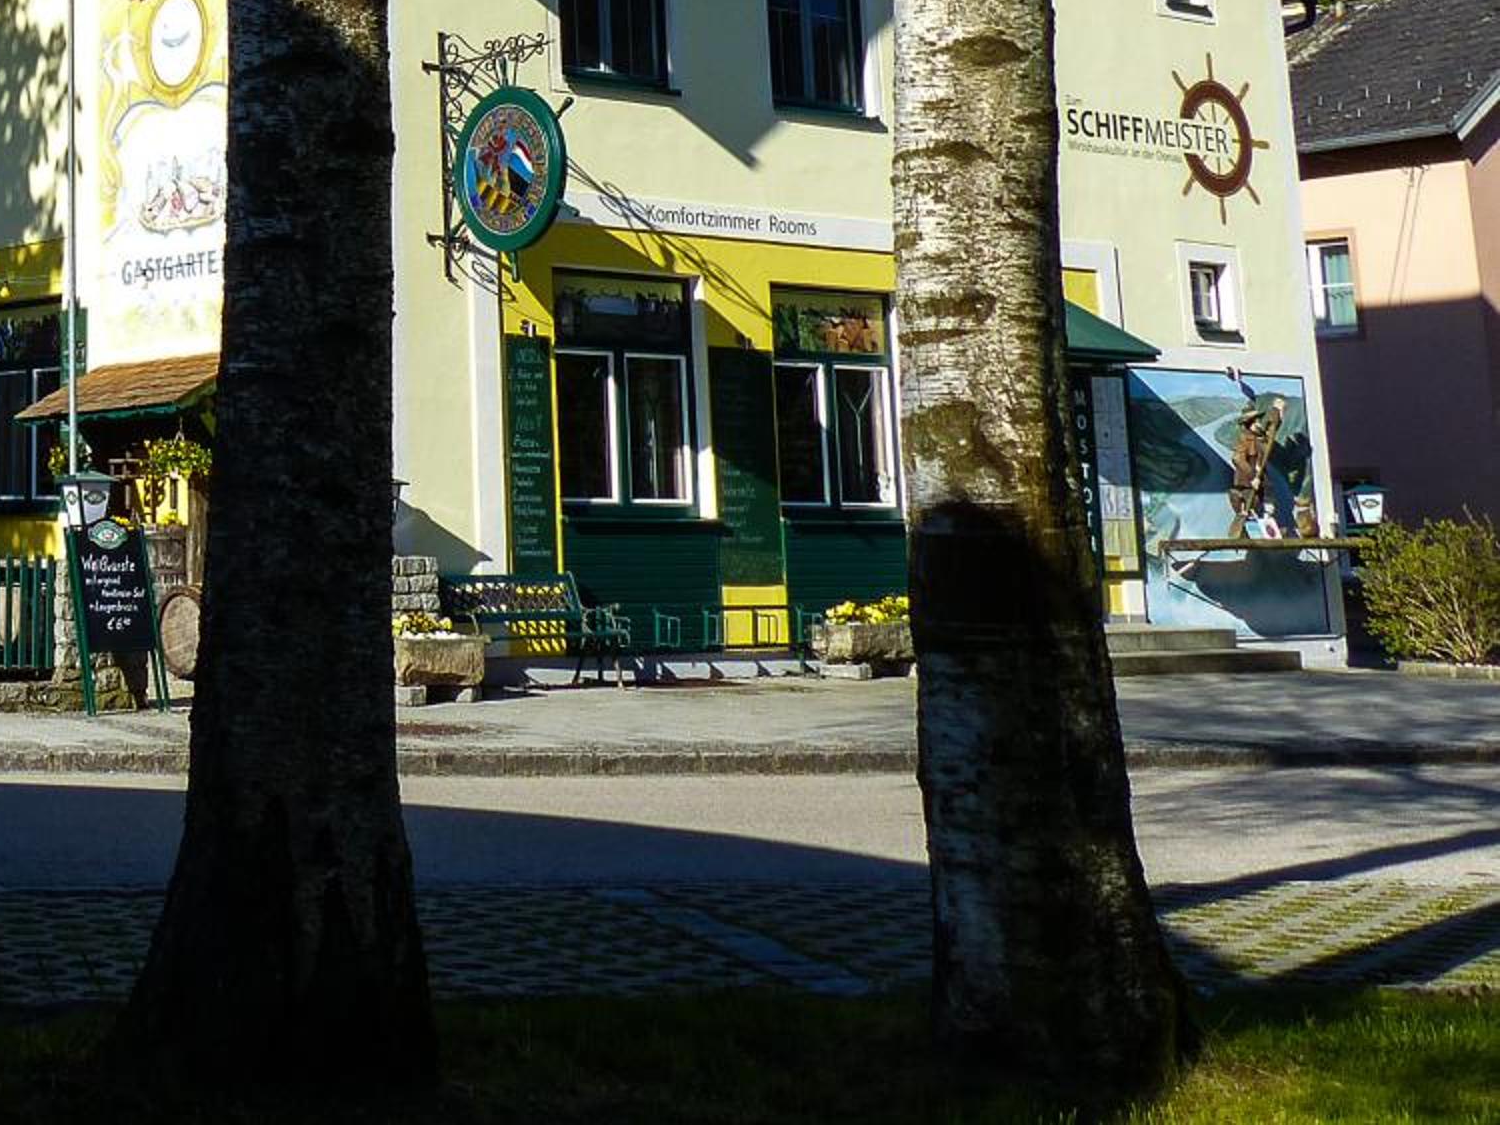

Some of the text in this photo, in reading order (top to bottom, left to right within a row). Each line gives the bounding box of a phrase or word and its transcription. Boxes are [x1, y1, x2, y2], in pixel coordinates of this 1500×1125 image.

[1066, 108, 1229, 155] SCHIFFMEISTER
[646, 204, 818, 236] Komfortzimmer Rooms
[121, 250, 218, 286] GASTGARTE
